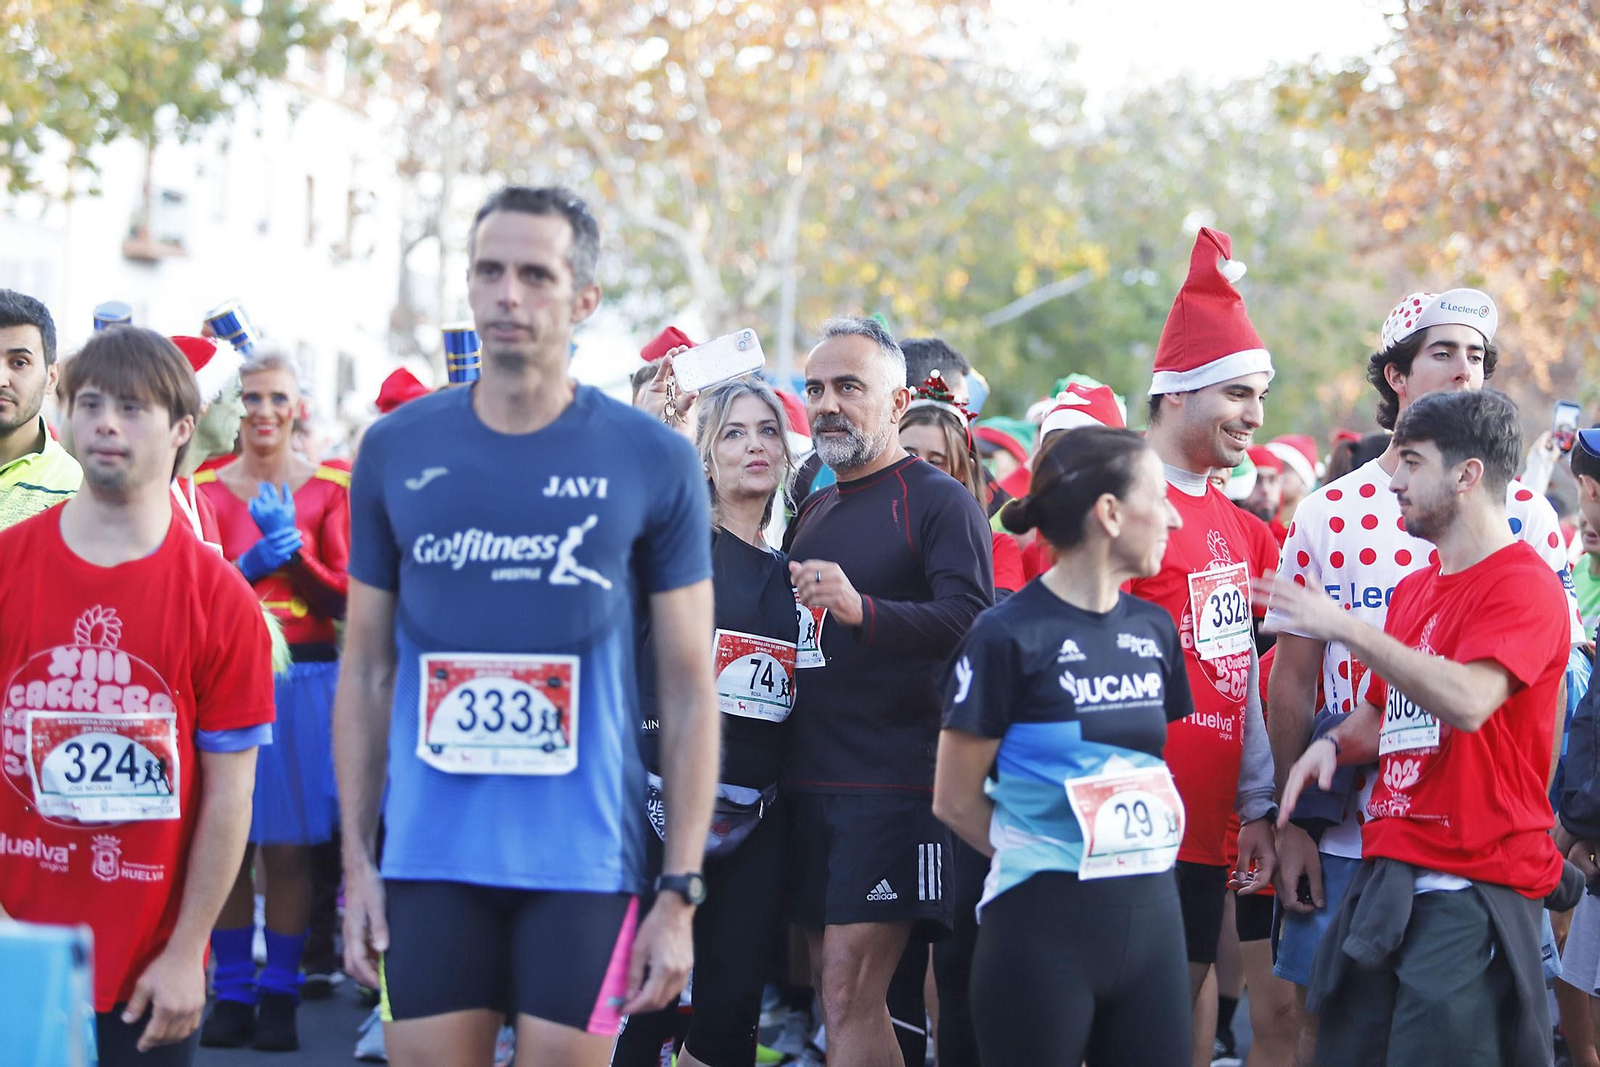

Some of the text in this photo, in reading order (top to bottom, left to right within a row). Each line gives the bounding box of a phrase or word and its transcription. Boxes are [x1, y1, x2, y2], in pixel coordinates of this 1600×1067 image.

[1440, 301, 1478, 315] E.Leclerc
[543, 476, 608, 498] JAVI
[1211, 590, 1242, 628] 332
[48, 647, 131, 684] XIII
[750, 658, 774, 693] 74
[9, 677, 174, 713] CARRERA
[458, 689, 532, 732] 333
[64, 741, 140, 783] 324
[1114, 800, 1153, 840] 29
[40, 860, 69, 872] original
[121, 868, 164, 881] HUELVA
[866, 892, 898, 901] adidas
